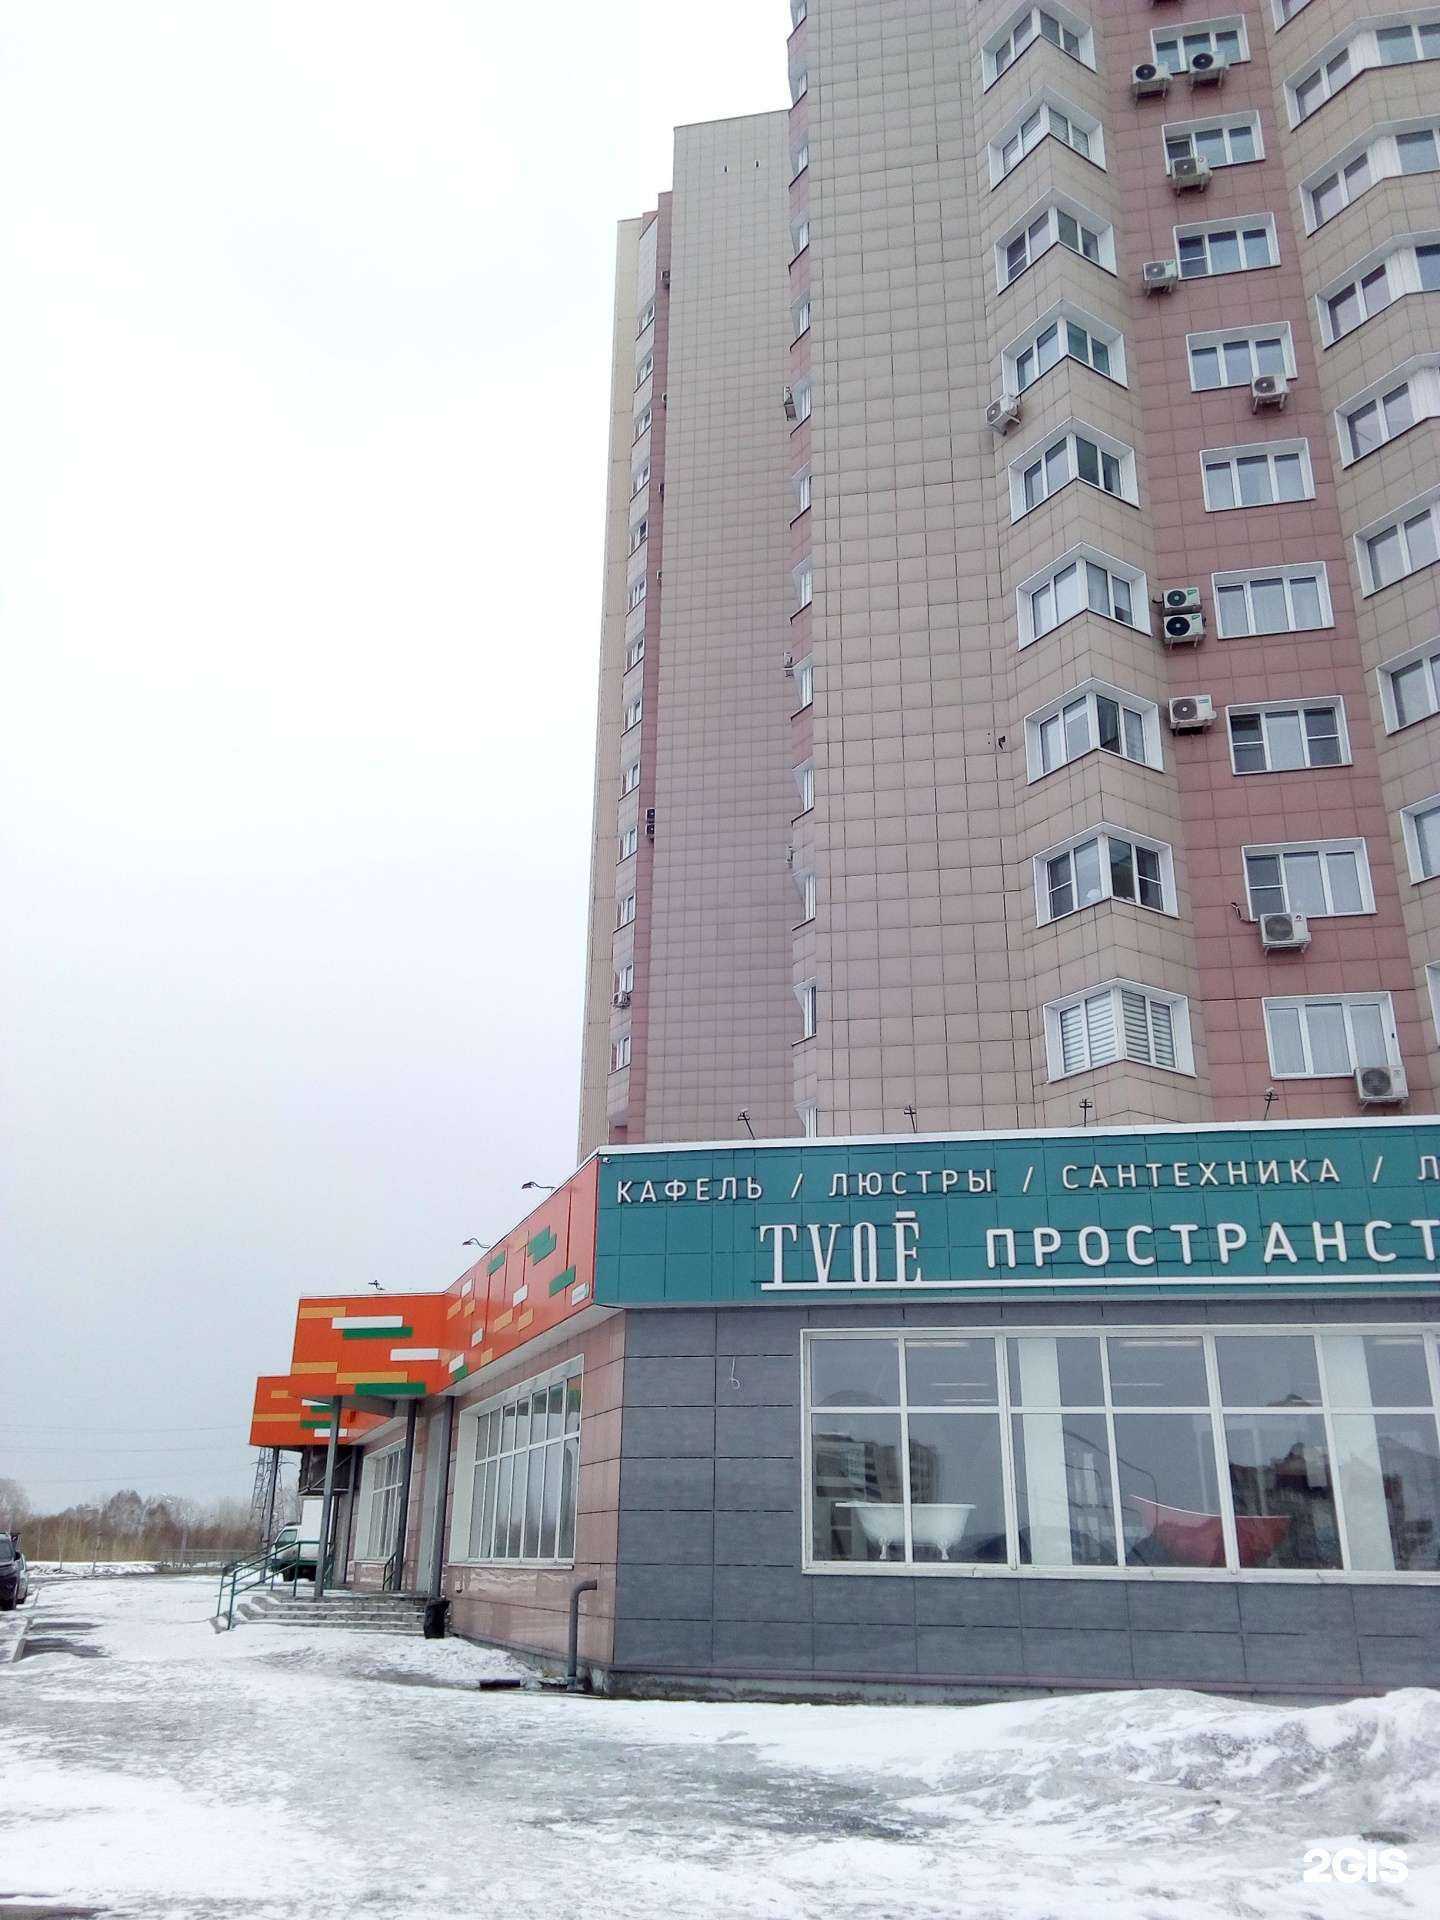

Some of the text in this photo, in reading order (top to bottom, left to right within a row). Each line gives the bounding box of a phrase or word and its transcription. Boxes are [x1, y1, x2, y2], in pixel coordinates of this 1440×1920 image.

[617, 1176, 763, 1204] КАФЕЛЬ
[829, 1168, 993, 1197] ЛЮСТРЫ
[1062, 1157, 1341, 1191] САНТЕХНИКА
